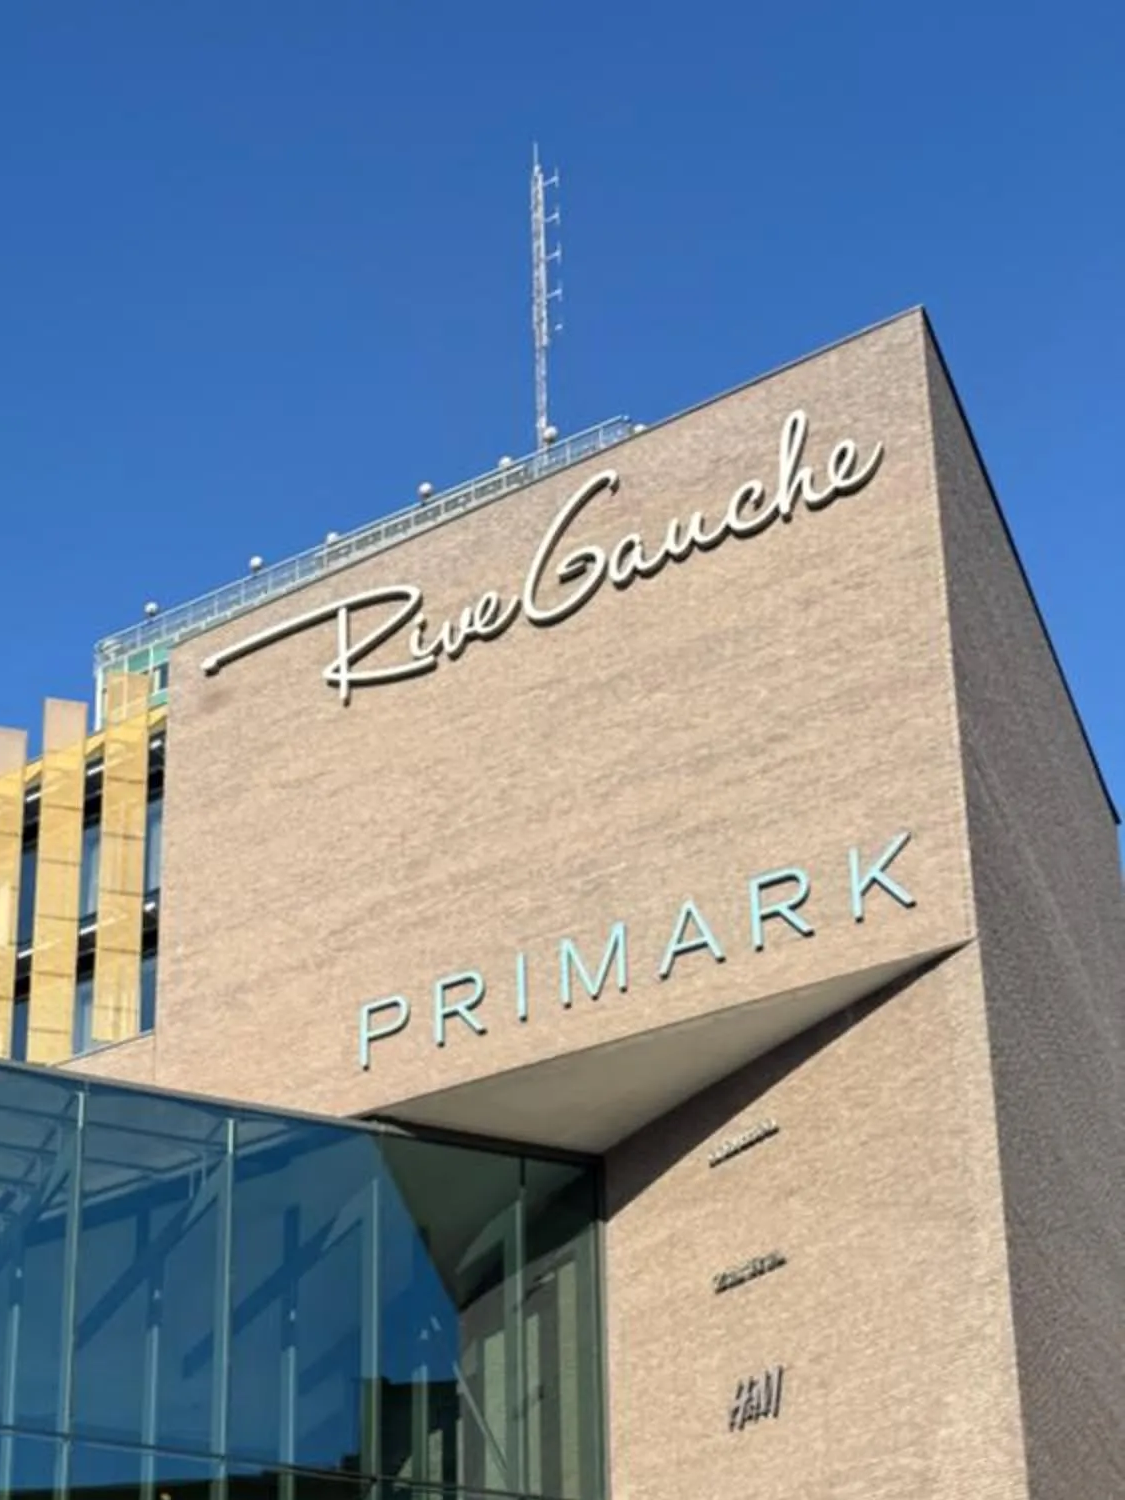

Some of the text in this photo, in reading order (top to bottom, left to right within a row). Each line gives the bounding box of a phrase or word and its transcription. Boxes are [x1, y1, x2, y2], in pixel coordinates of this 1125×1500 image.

[201, 408, 884, 706] Rive Gauche
[358, 829, 917, 1071] PRIMARK
